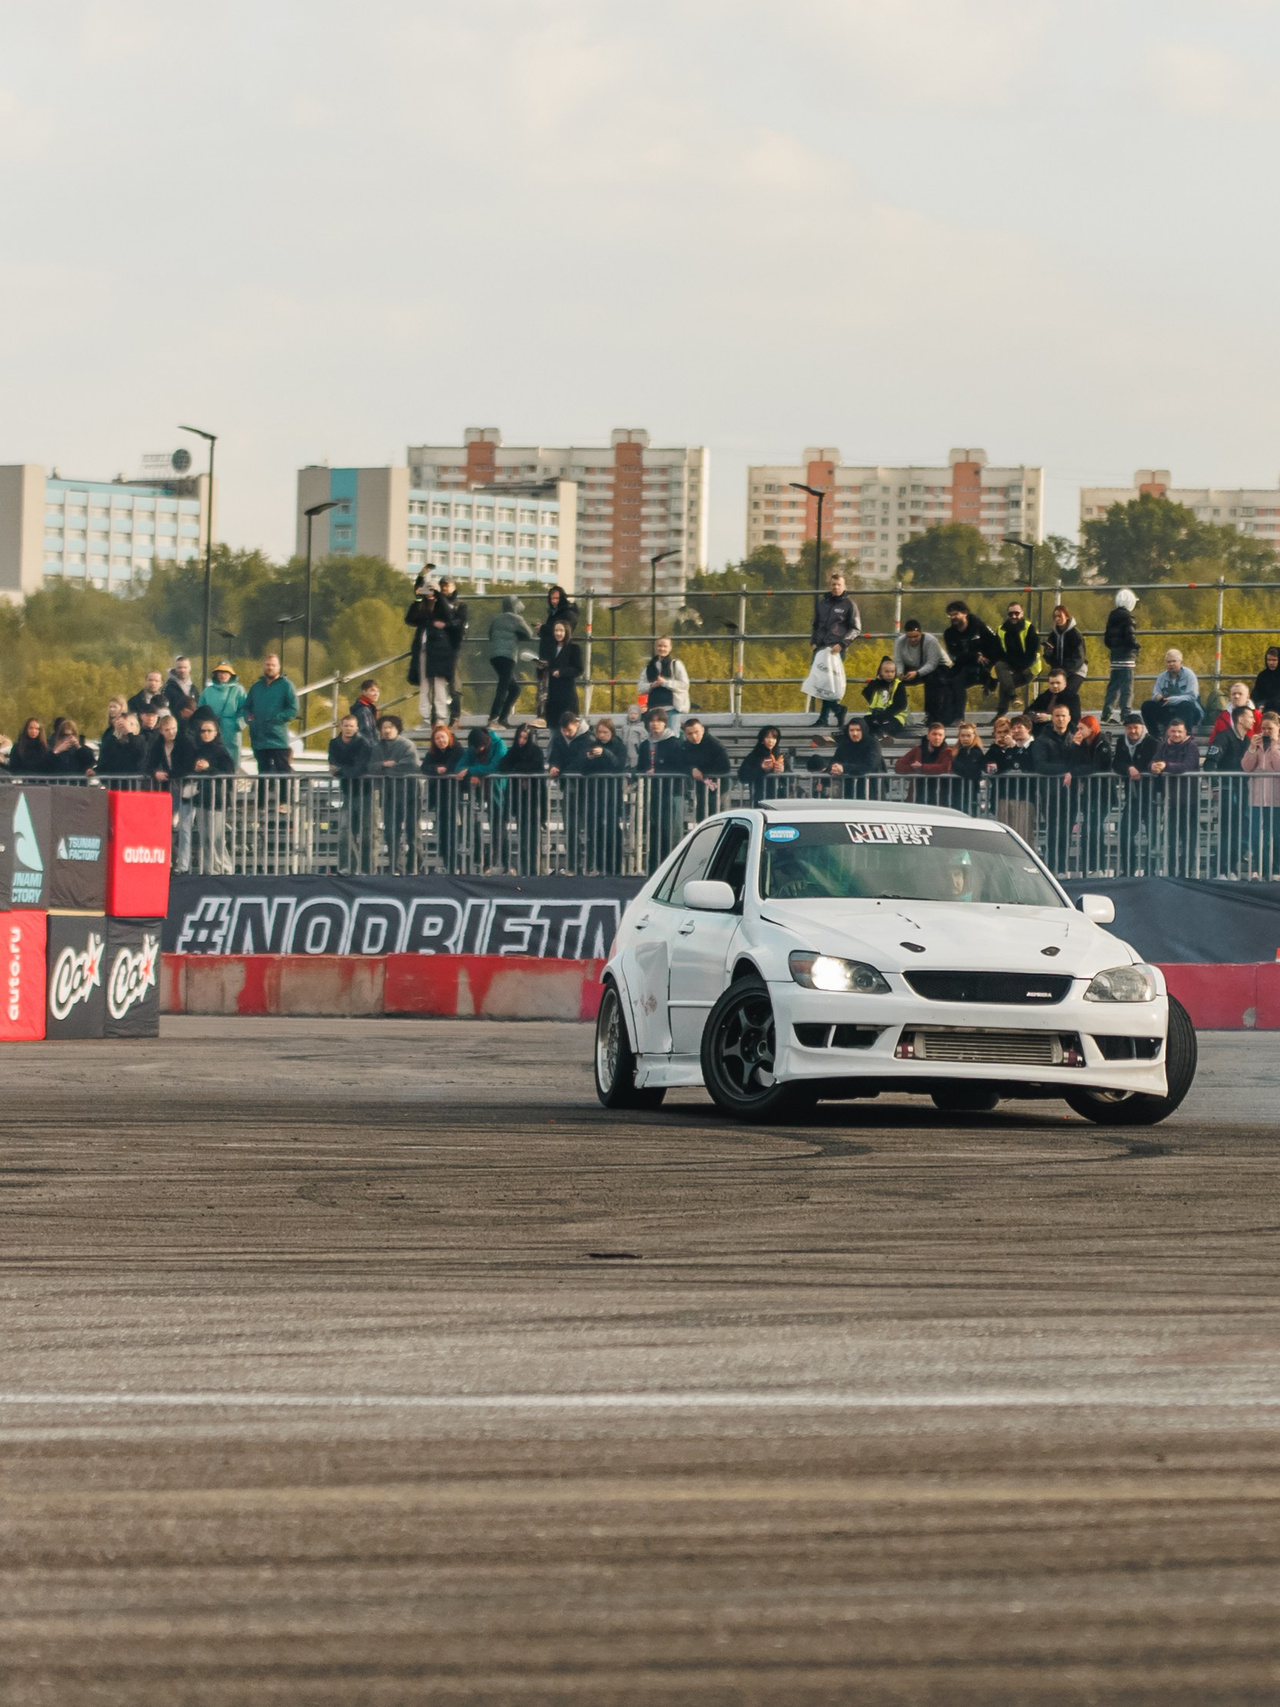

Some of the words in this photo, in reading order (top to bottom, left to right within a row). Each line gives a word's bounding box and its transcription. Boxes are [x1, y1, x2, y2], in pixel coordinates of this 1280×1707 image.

[888, 824, 933, 836] DRIFT
[68, 837, 101, 849] TSUNAMI
[892, 834, 931, 845] FEST
[68, 849, 100, 861] FACTORY
[124, 846, 165, 863] auto.ru
[11, 888, 42, 903] CTORY
[8, 926, 21, 1020] auto.ru
